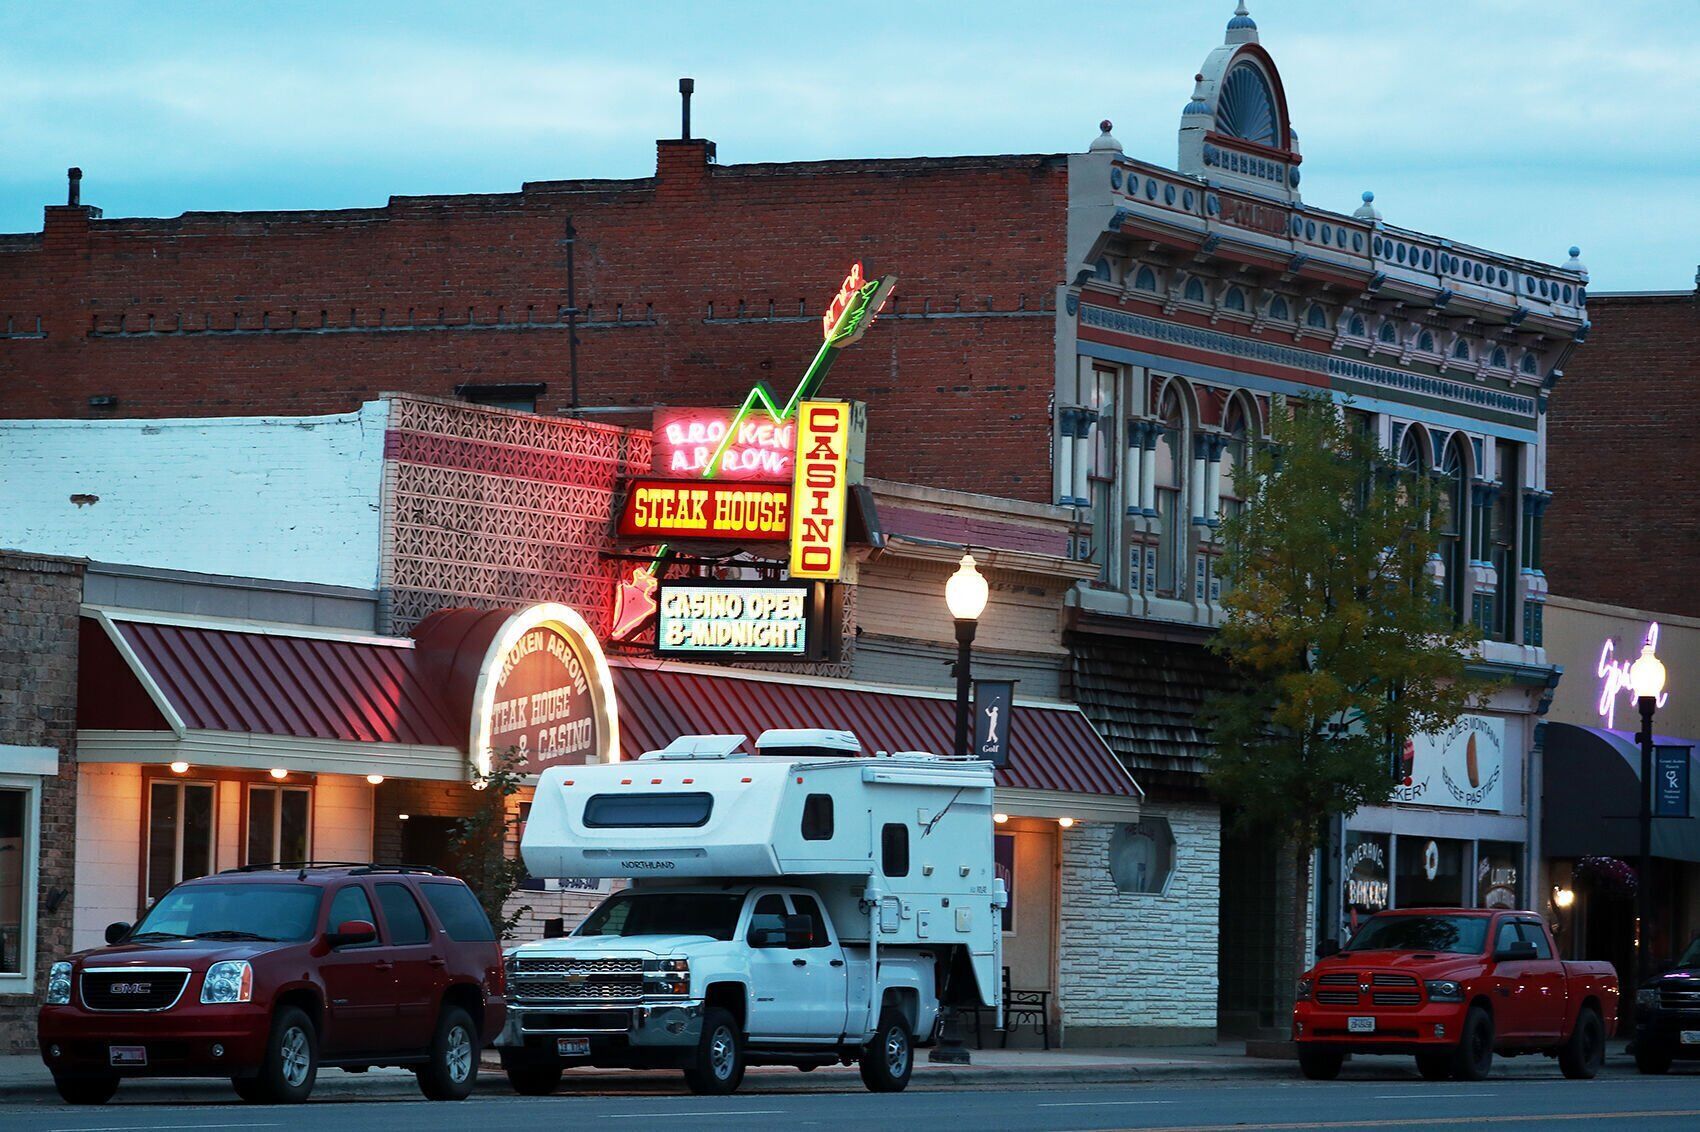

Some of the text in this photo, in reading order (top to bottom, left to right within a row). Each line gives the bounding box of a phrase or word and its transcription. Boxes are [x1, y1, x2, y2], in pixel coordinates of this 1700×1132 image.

[666, 420, 793, 450] BROKEN
[671, 448, 789, 473] ARROW
[801, 408, 839, 571] CASINO
[634, 488, 787, 532] STEAK HOUSE
[663, 593, 806, 620] CASINO OPEN
[499, 631, 587, 696] BROKEN ARROW
[490, 686, 571, 735] TEAK HOUSE
[518, 717, 592, 766] & CASINO
[982, 744, 1000, 753] Golf
[1390, 776, 1430, 801] KERY
[621, 860, 676, 870] NORTHLAND
[1348, 879, 1388, 909] BAKERY
[110, 982, 152, 994] GMC
